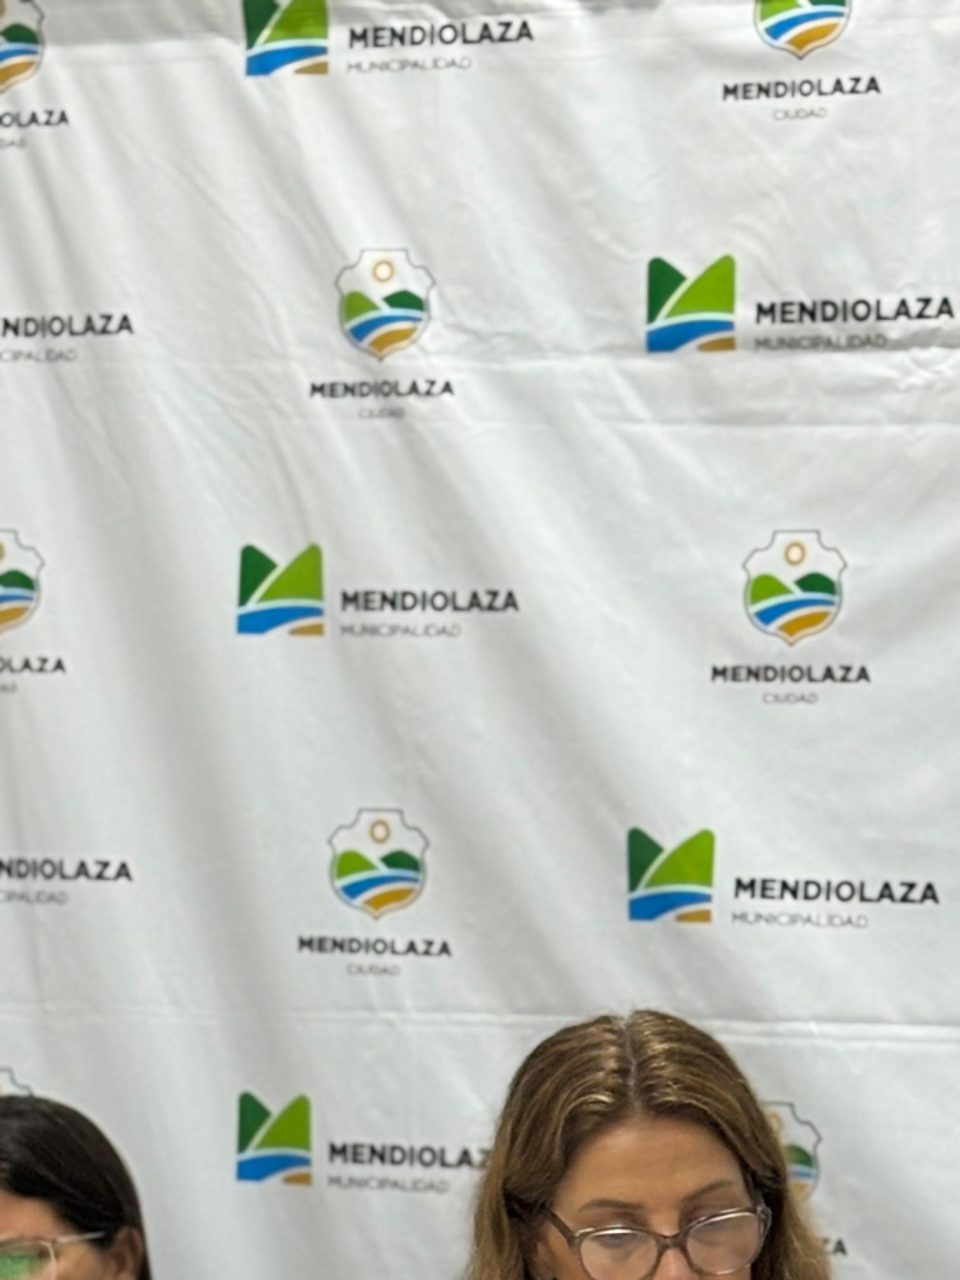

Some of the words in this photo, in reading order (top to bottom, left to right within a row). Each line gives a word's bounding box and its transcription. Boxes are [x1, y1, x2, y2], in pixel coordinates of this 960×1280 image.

[349, 21, 533, 48] MENDIOLAZA
[723, 77, 880, 100] MENDIOLAZA
[0, 110, 68, 128] OLAZA
[756, 297, 954, 323] MENDIOLAZA
[1, 314, 134, 338] NDIOLAZA
[754, 334, 888, 351] MUNICIPALIDAD
[310, 380, 453, 398] MENDIOLAZA
[341, 590, 518, 612] MENDIOLAZA
[711, 665, 870, 683] MENDIOLAZA
[0, 859, 132, 881] NDIOLAZA
[735, 878, 939, 904] MENDIOLAZA
[732, 912, 867, 928] MUNICIPALIDAD
[298, 937, 451, 956] MENDIOLAZA
[328, 1142, 491, 1169] MENDIOLAZ
